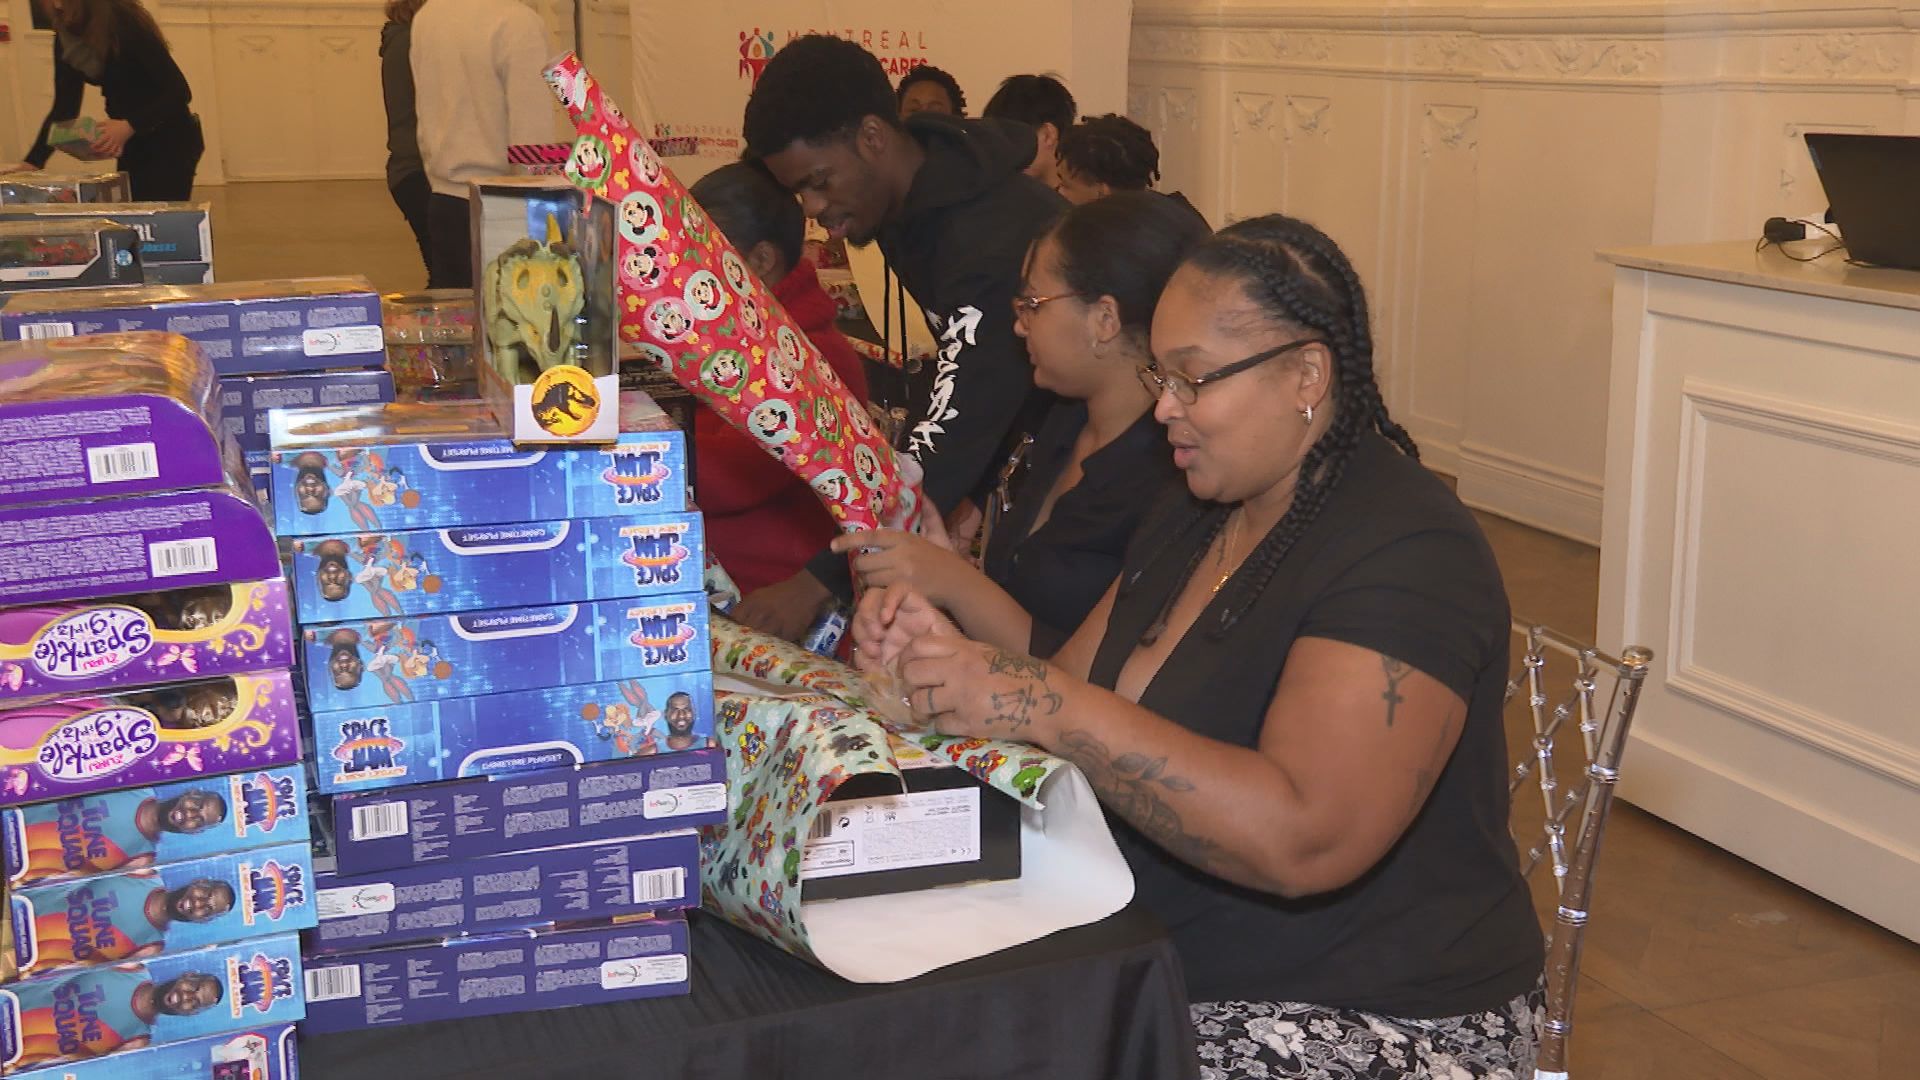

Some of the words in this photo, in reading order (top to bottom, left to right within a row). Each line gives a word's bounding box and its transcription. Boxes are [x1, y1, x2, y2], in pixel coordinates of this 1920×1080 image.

[35, 619, 151, 672] Sparkle
[40, 719, 157, 775] Sparkle
[81, 798, 110, 859] TUNE
[91, 890, 119, 949] TUNE
[78, 984, 107, 1042] TUNE
